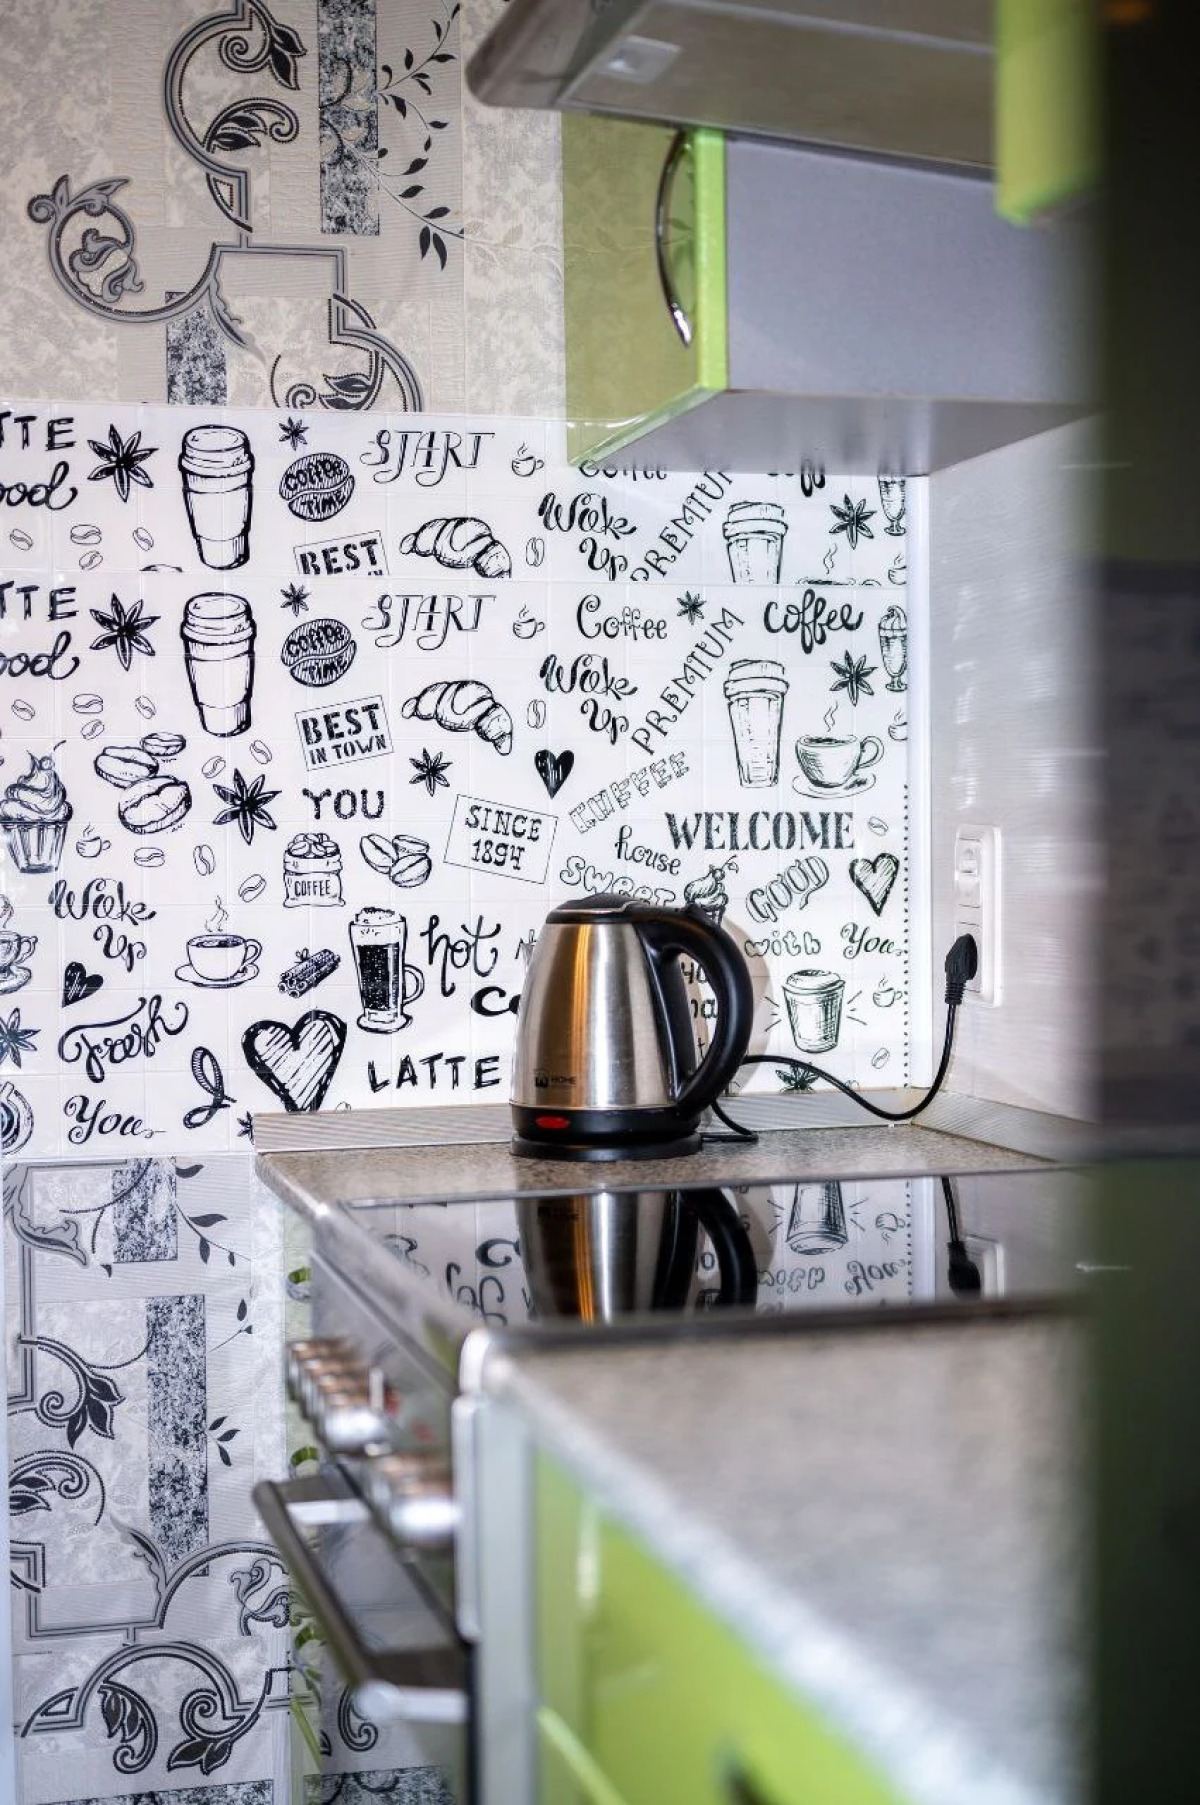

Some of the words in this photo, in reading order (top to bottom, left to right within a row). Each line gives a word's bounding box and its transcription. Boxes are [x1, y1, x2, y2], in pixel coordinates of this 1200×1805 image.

[360, 429, 495, 487] START
[361, 595, 497, 650] START
[576, 594, 668, 641] Coffee
[631, 608, 745, 756] PREMIUM
[302, 703, 379, 746] BEST
[309, 747, 328, 765] IN
[331, 735, 387, 760] TOWN
[302, 788, 384, 820] YOU
[465, 805, 542, 842] SINCE
[614, 825, 681, 875] house
[664, 811, 854, 850] WELCOME
[471, 839, 525, 871] 1894
[294, 880, 331, 897] COFFEE
[745, 855, 830, 923] GOOD
[420, 914, 501, 997] hot
[744, 930, 822, 957] with
[367, 1052, 502, 1093] LATTE
